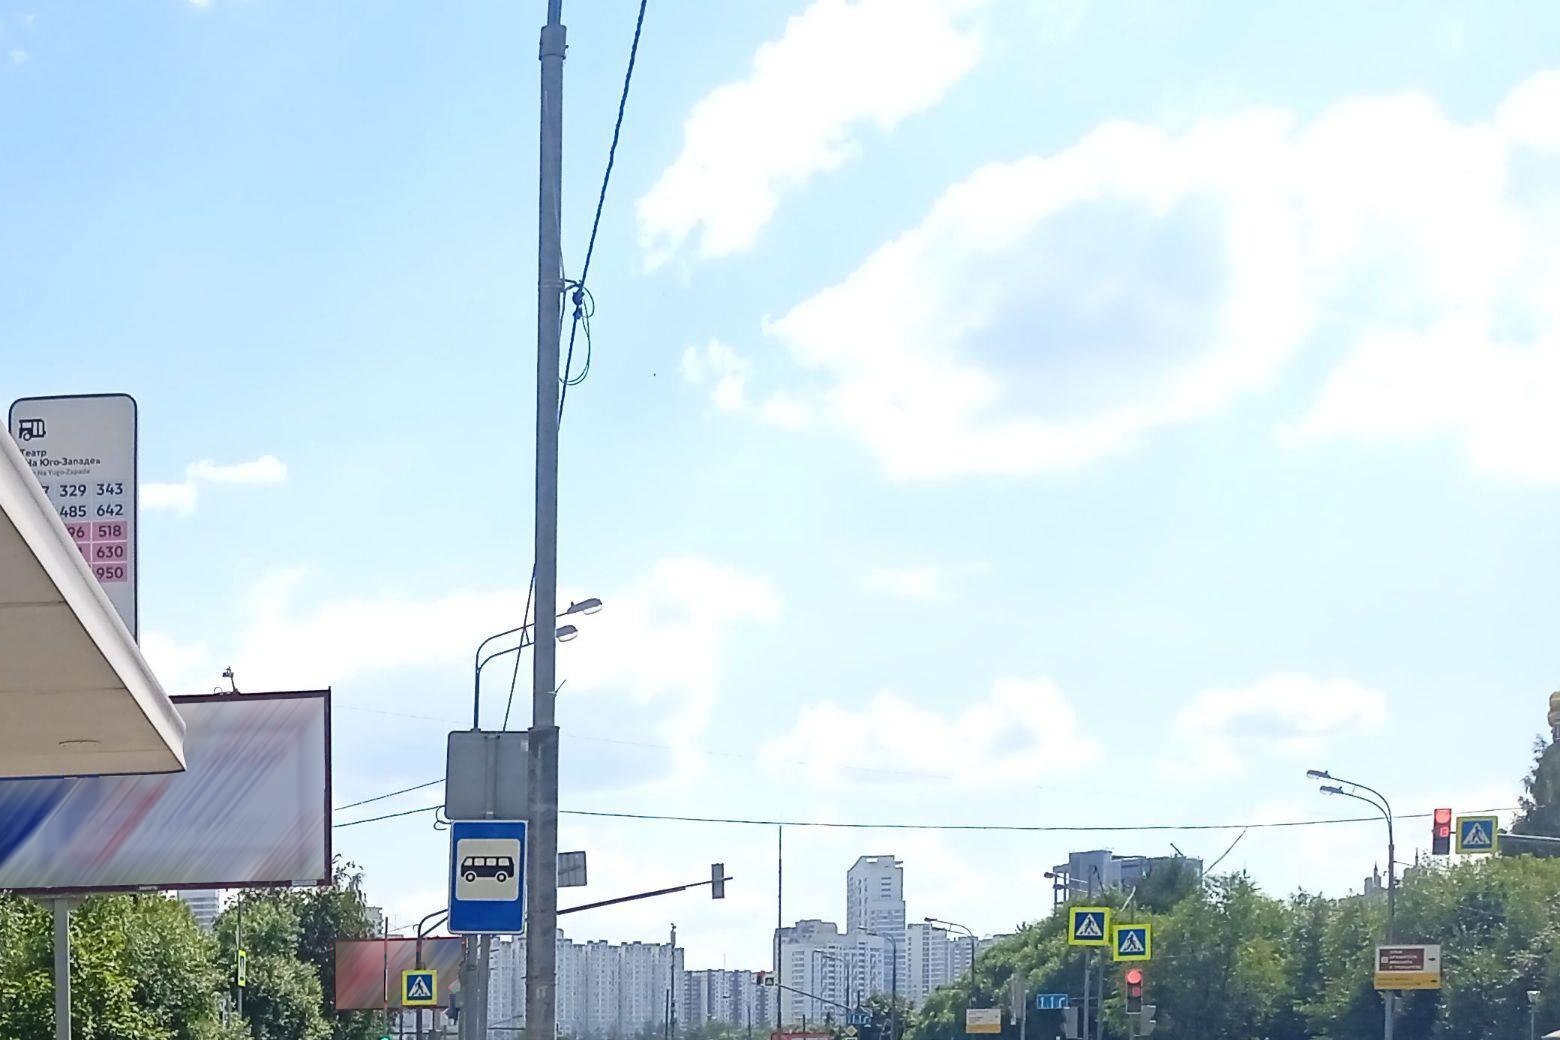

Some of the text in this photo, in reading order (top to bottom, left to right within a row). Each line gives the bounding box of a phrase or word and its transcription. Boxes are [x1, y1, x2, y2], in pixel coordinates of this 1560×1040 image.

[20, 449, 47, 458] Театр
[27, 459, 38, 468] На
[59, 484, 87, 498] 329
[96, 483, 123, 496] 343
[59, 504, 124, 518] 485 642
[67, 525, 122, 538] 96 518
[96, 546, 124, 558] 630
[96, 566, 124, 579] 950
